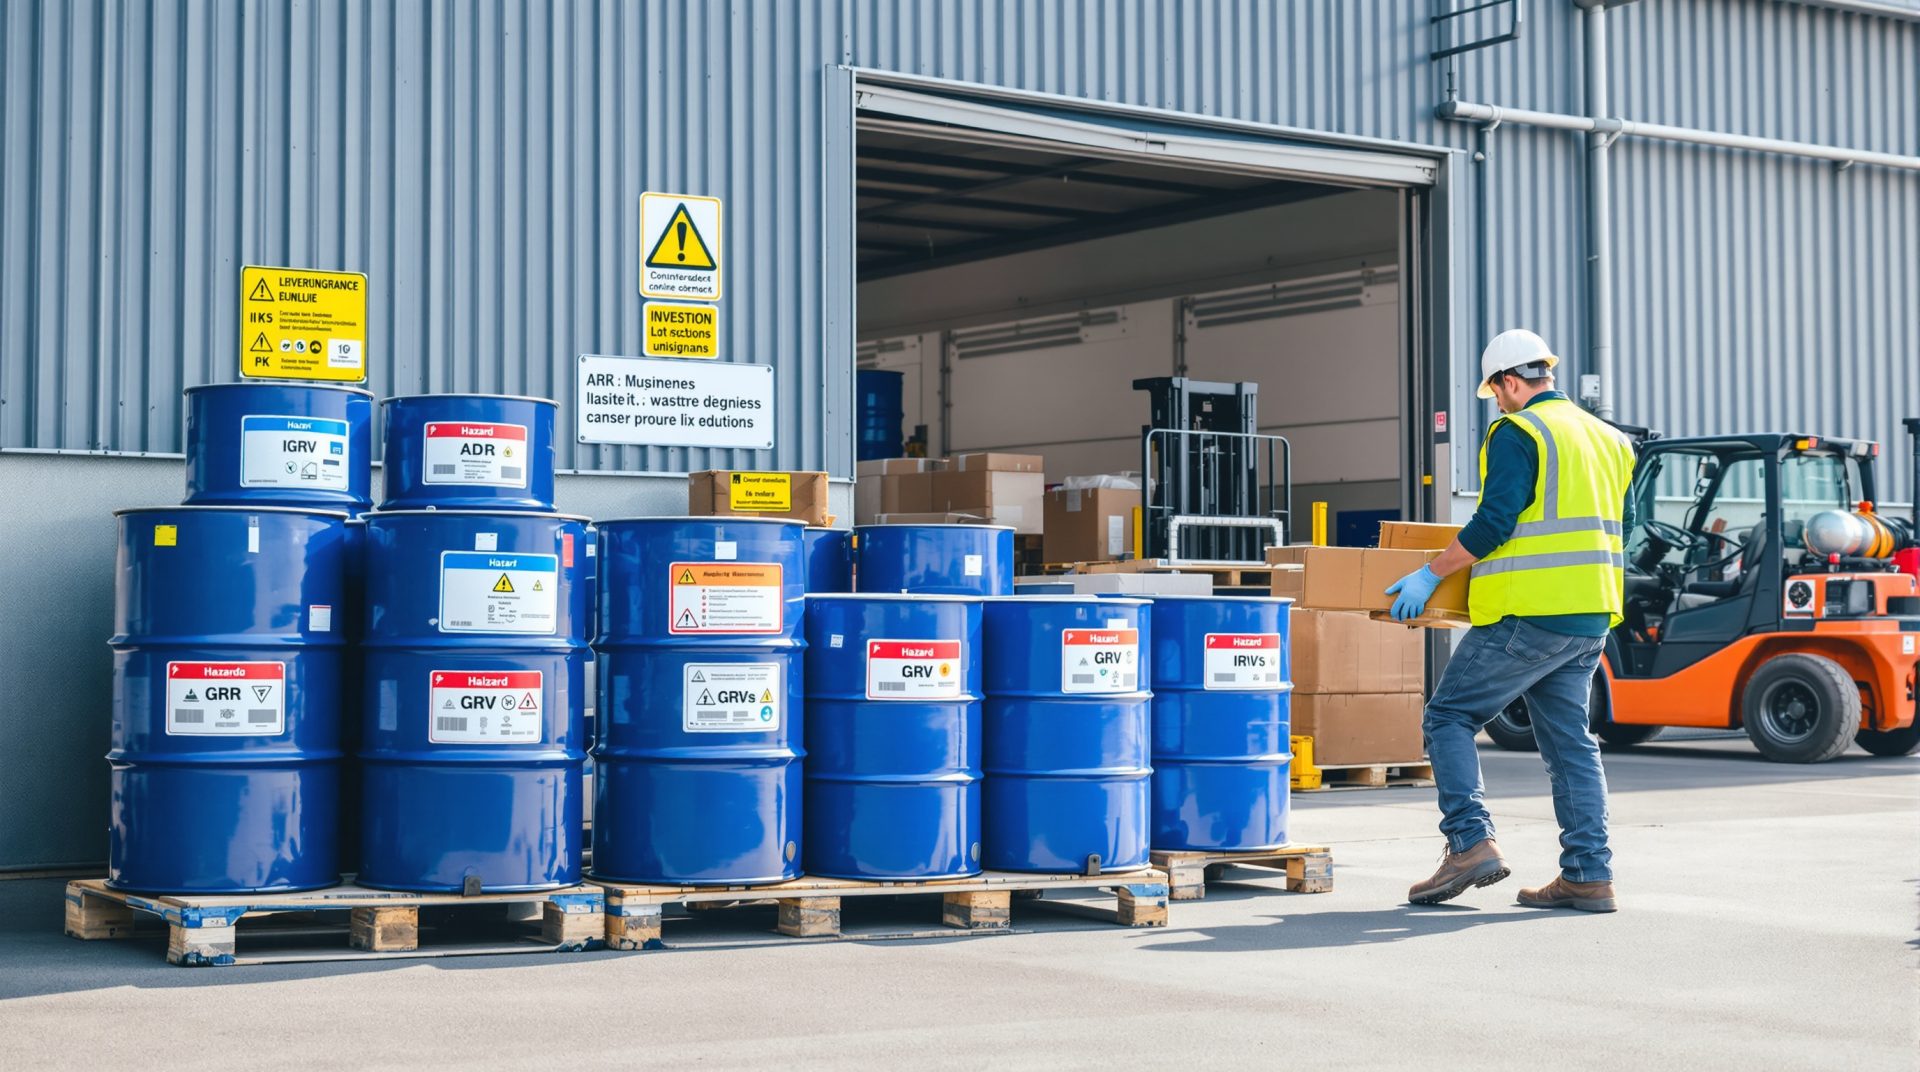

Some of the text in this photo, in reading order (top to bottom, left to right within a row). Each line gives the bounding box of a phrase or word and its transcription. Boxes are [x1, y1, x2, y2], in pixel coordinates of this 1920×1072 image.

[651, 310, 712, 325] INVESTION
[651, 326, 667, 337] Lot
[255, 357, 269, 367] PK
[586, 373, 615, 387] ARR
[625, 374, 696, 391] Musinenes
[586, 412, 631, 425] canser
[634, 413, 677, 428] proure
[698, 415, 754, 429] edutions
[461, 426, 494, 436] Hazard
[282, 439, 317, 453] IGRV
[460, 442, 496, 456] ADR
[901, 647, 934, 657] Hazard
[1094, 651, 1122, 665] GRV
[901, 665, 934, 678] GRV
[204, 686, 242, 701] GRR
[717, 690, 756, 704] GRVs
[460, 695, 497, 710] GRV
